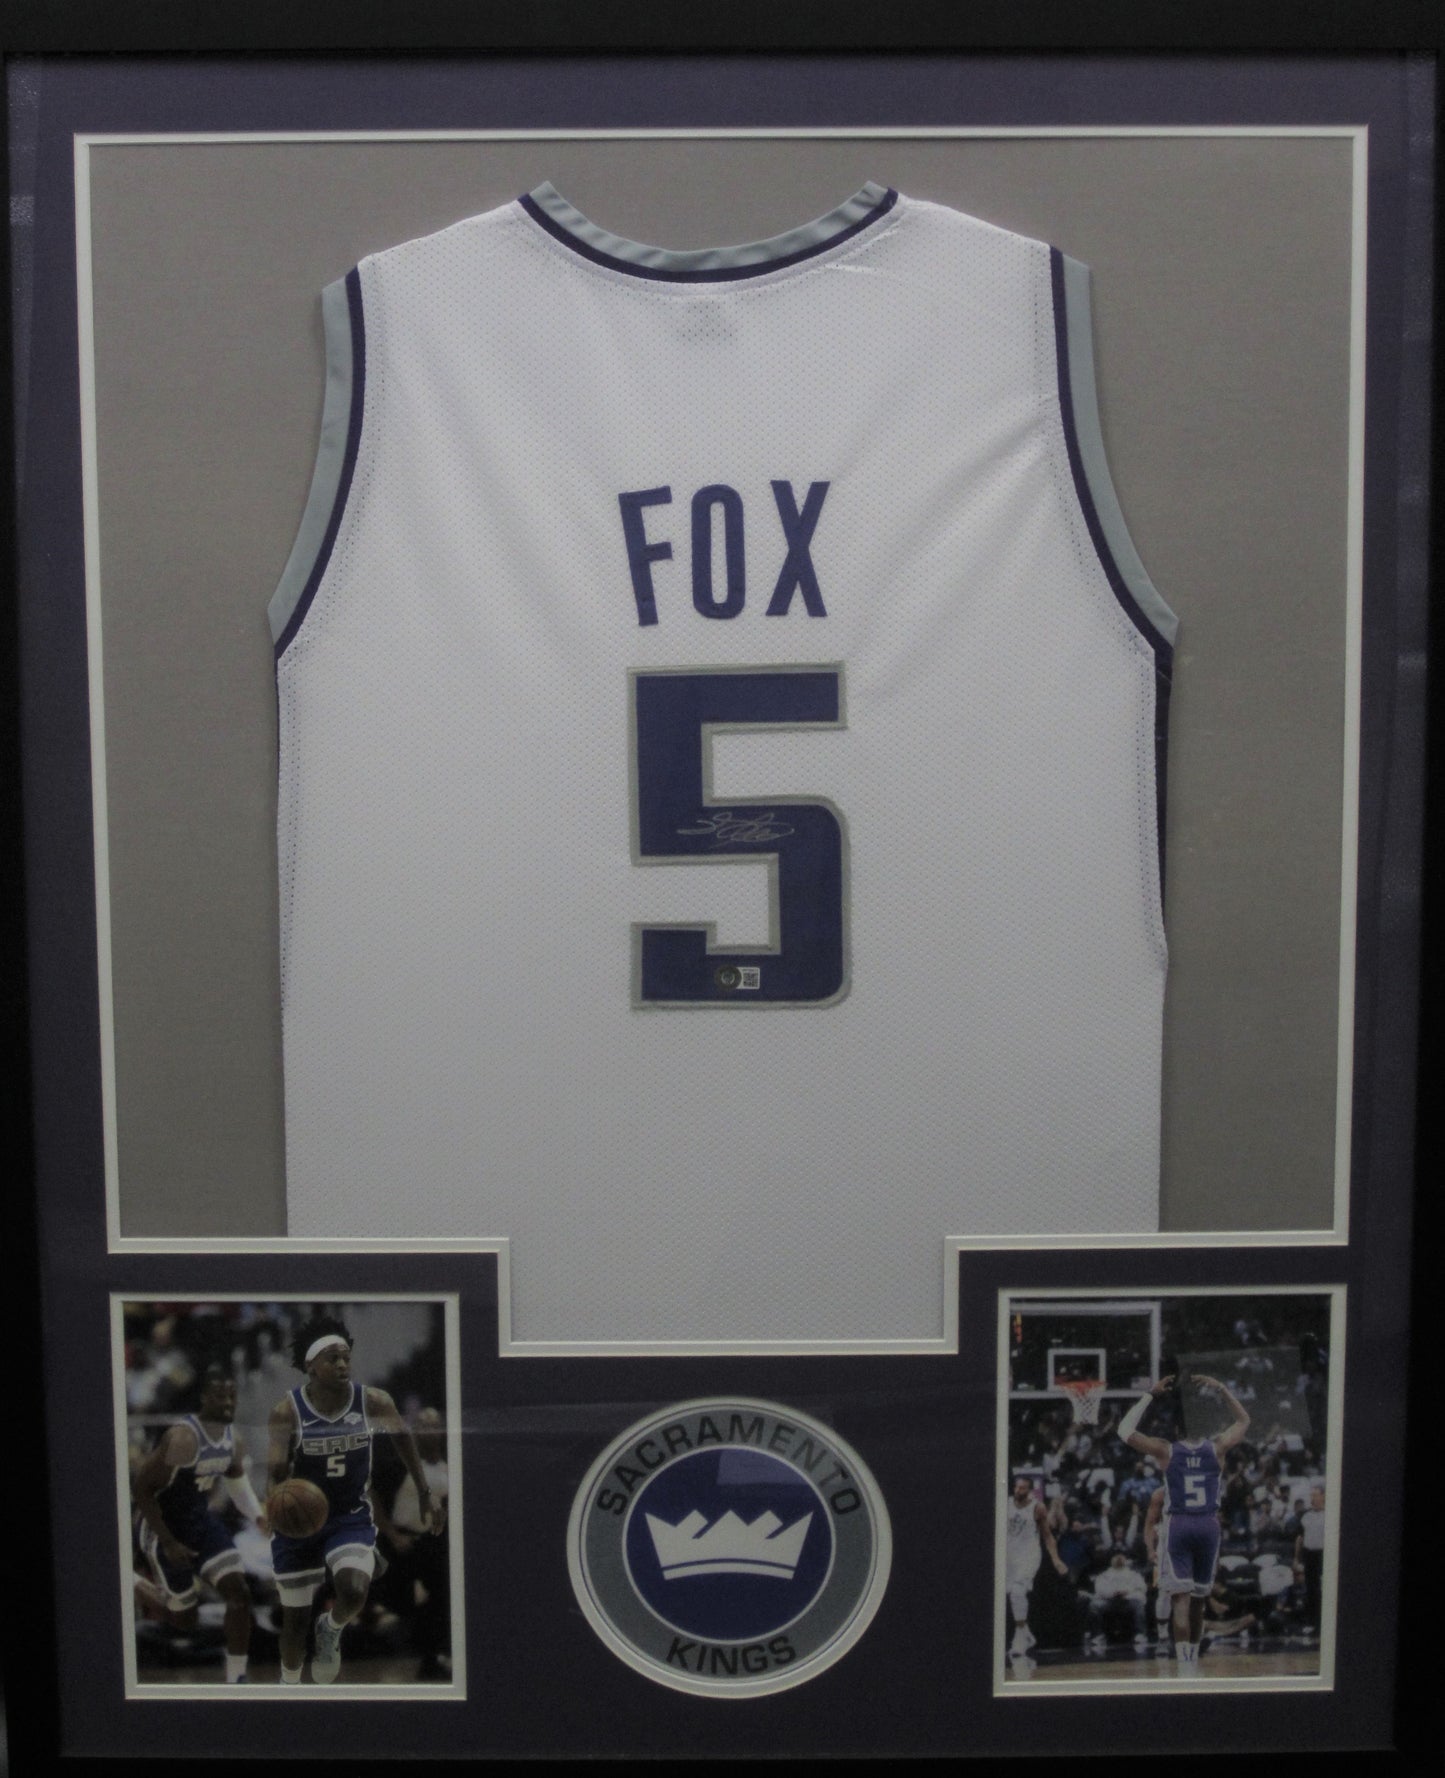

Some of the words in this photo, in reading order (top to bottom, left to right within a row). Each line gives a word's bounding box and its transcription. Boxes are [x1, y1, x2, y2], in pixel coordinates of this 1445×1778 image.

[618, 479, 831, 627] FOX
[627, 659, 853, 1013] 5
[301, 1431, 369, 1456] SAC
[326, 1454, 346, 1478] 5
[596, 1413, 862, 1517] SACRAMENTO
[1183, 1474, 1207, 1508] 5
[665, 1634, 798, 1675] KINGS
